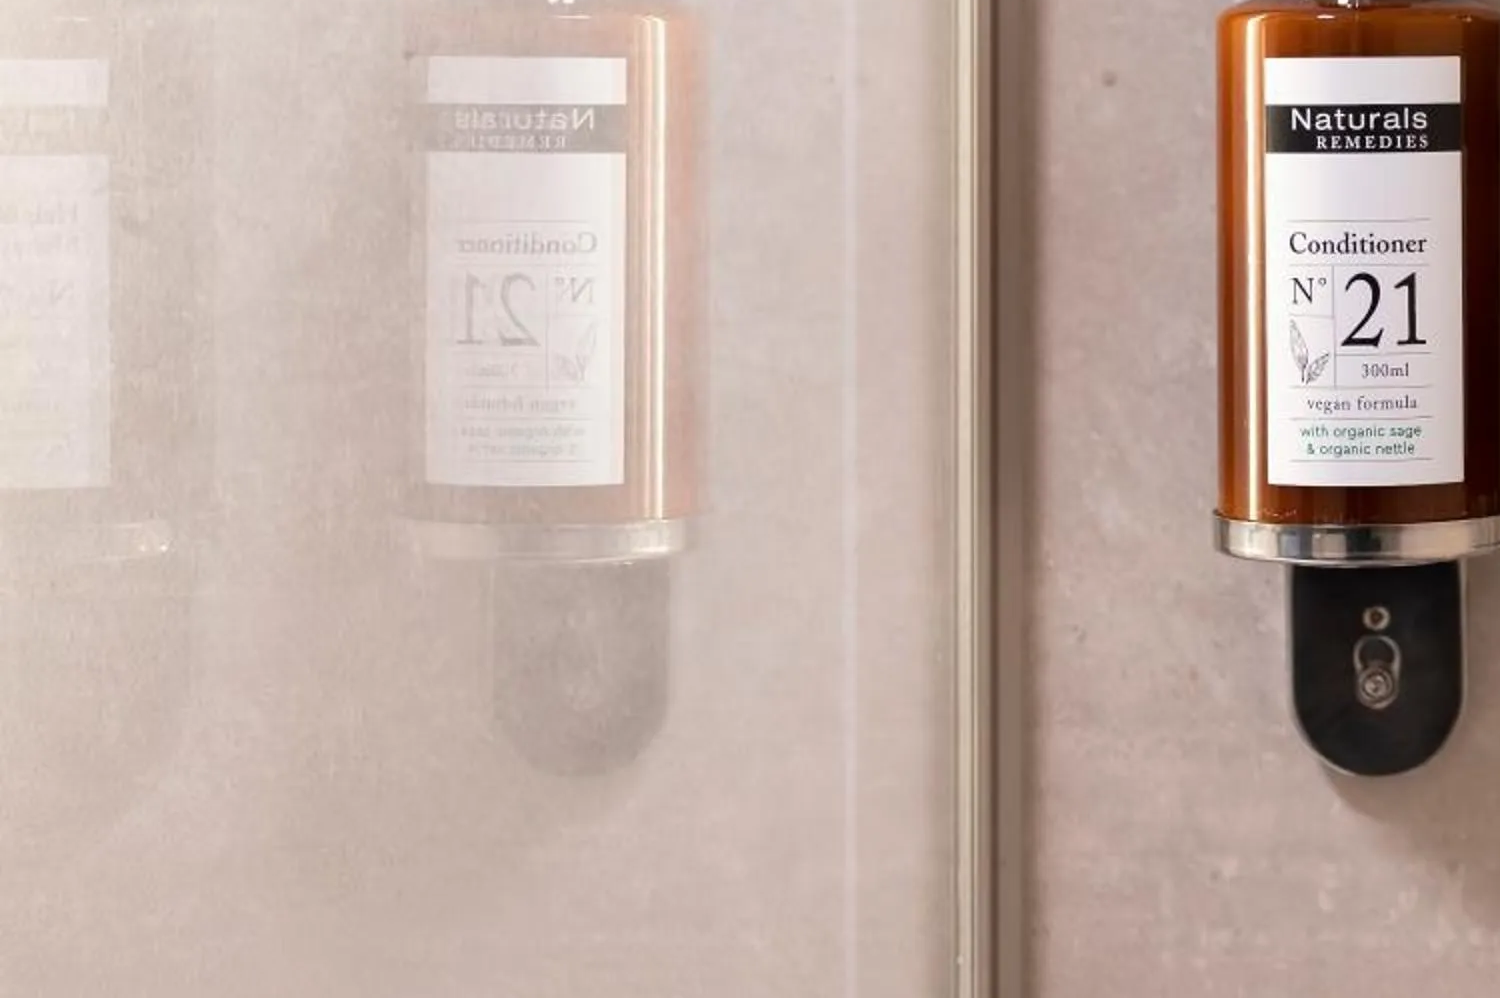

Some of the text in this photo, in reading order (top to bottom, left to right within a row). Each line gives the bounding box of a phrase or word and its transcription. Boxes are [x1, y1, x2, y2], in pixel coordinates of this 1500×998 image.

[1291, 107, 1428, 131] Naturals
[1316, 134, 1429, 150] REMEDIES
[1289, 231, 1428, 255] Conditioner
[1340, 271, 1427, 348] 21
[1361, 363, 1410, 379] 300ml
[1307, 395, 1418, 414] vegan formula
[1300, 425, 1423, 440] with organic sage
[1307, 442, 1415, 458] & organic nettle
